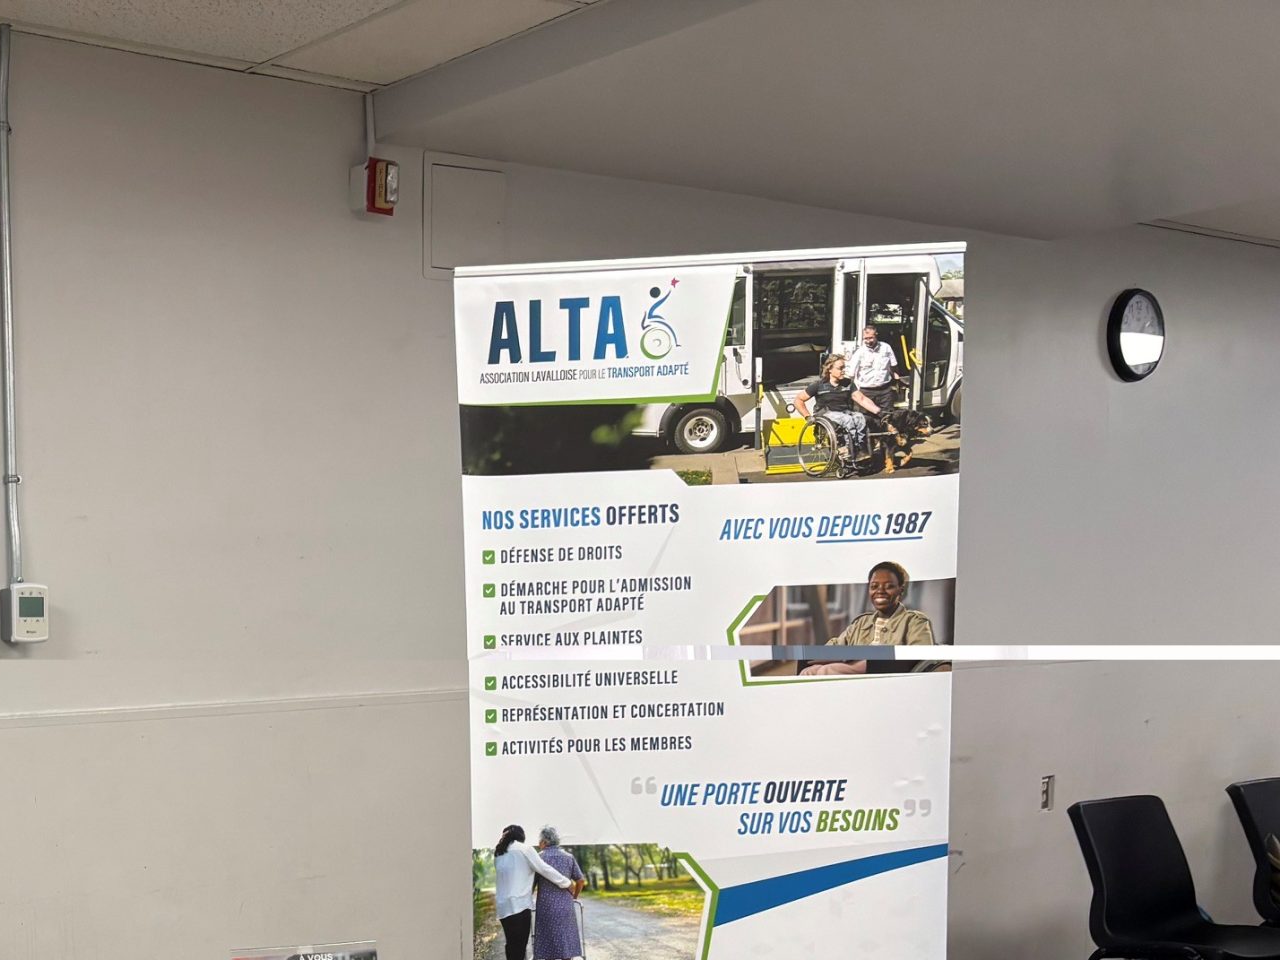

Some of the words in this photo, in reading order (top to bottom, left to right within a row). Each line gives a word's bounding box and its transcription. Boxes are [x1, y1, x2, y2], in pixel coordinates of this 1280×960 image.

[487, 295, 630, 365] ALTA
[479, 371, 530, 385] ASSOCIATION
[531, 368, 578, 383] LAVALLOISE
[578, 369, 596, 381] POUR
[598, 368, 606, 379] LE
[607, 365, 655, 378] TRANSPORT
[656, 361, 689, 376] ADAPTÉ
[482, 509, 514, 530] NOS
[519, 506, 601, 529] SERVICES
[606, 503, 680, 526] OFFERTS
[719, 518, 765, 541] AVEC
[769, 516, 814, 539] VOUS
[817, 514, 882, 537] DEPUIS
[884, 511, 933, 535] 1987
[500, 546, 554, 564] DÉFENSE
[558, 547, 574, 562] DE
[578, 545, 623, 561] DROITS
[500, 580, 568, 597] DÉMARCHE
[572, 579, 605, 595] POUR
[609, 576, 692, 593] L'ADMISSION
[499, 601, 516, 616] AU
[519, 598, 593, 614] TRANSPORT
[596, 593, 644, 612] ADAPTÉ
[500, 632, 551, 647] SERVICE
[555, 632, 580, 647] AUX
[584, 629, 643, 646] PLAINTES
[501, 670, 592, 690] ACCESSIBILITÉ
[595, 670, 678, 687] UNIVERSELLE
[501, 704, 609, 723] REPRÉSENTATION
[612, 705, 627, 719] ET
[630, 701, 725, 719] CONCERTATION
[501, 737, 564, 755] ACTIVITÉS
[567, 738, 601, 753] POUR
[604, 737, 626, 752] LES
[630, 735, 693, 751] MEMBRES
[660, 783, 700, 807] UNE
[702, 782, 762, 806] PORTE
[763, 779, 848, 804] OUVERTE
[737, 812, 774, 836] SUR
[777, 810, 813, 835] VOS
[815, 808, 900, 833] BESOINS
